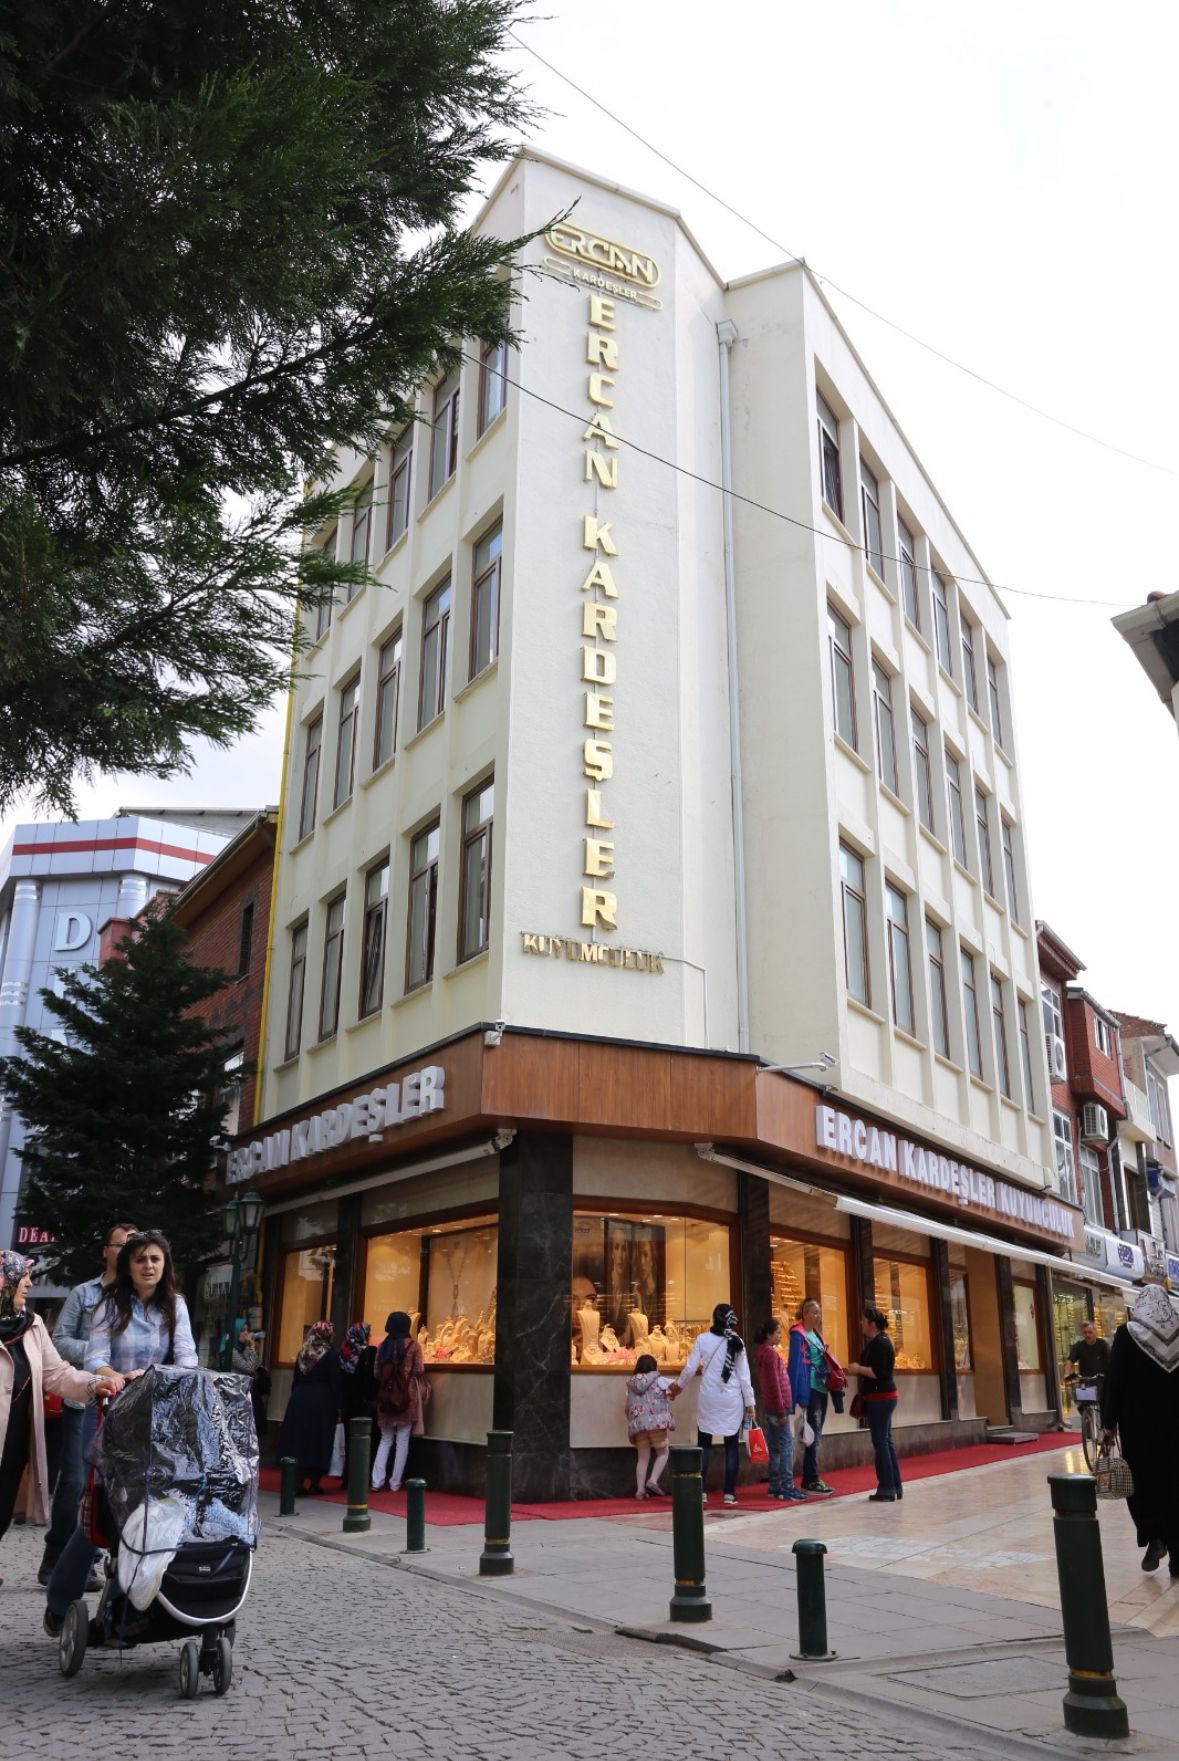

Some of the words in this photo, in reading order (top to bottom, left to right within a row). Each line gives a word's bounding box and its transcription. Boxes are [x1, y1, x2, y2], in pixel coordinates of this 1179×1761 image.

[551, 225, 653, 284] ERCAN
[583, 294, 620, 490] ERCAN
[580, 514, 619, 931] KARDEŞLER
[226, 1129, 291, 1185] ERCAN
[290, 1065, 445, 1161] KARDEŞLER
[816, 1105, 897, 1171] ERCAN
[898, 1139, 996, 1209] KARDEŞLER
[18, 1226, 56, 1243] DEA
